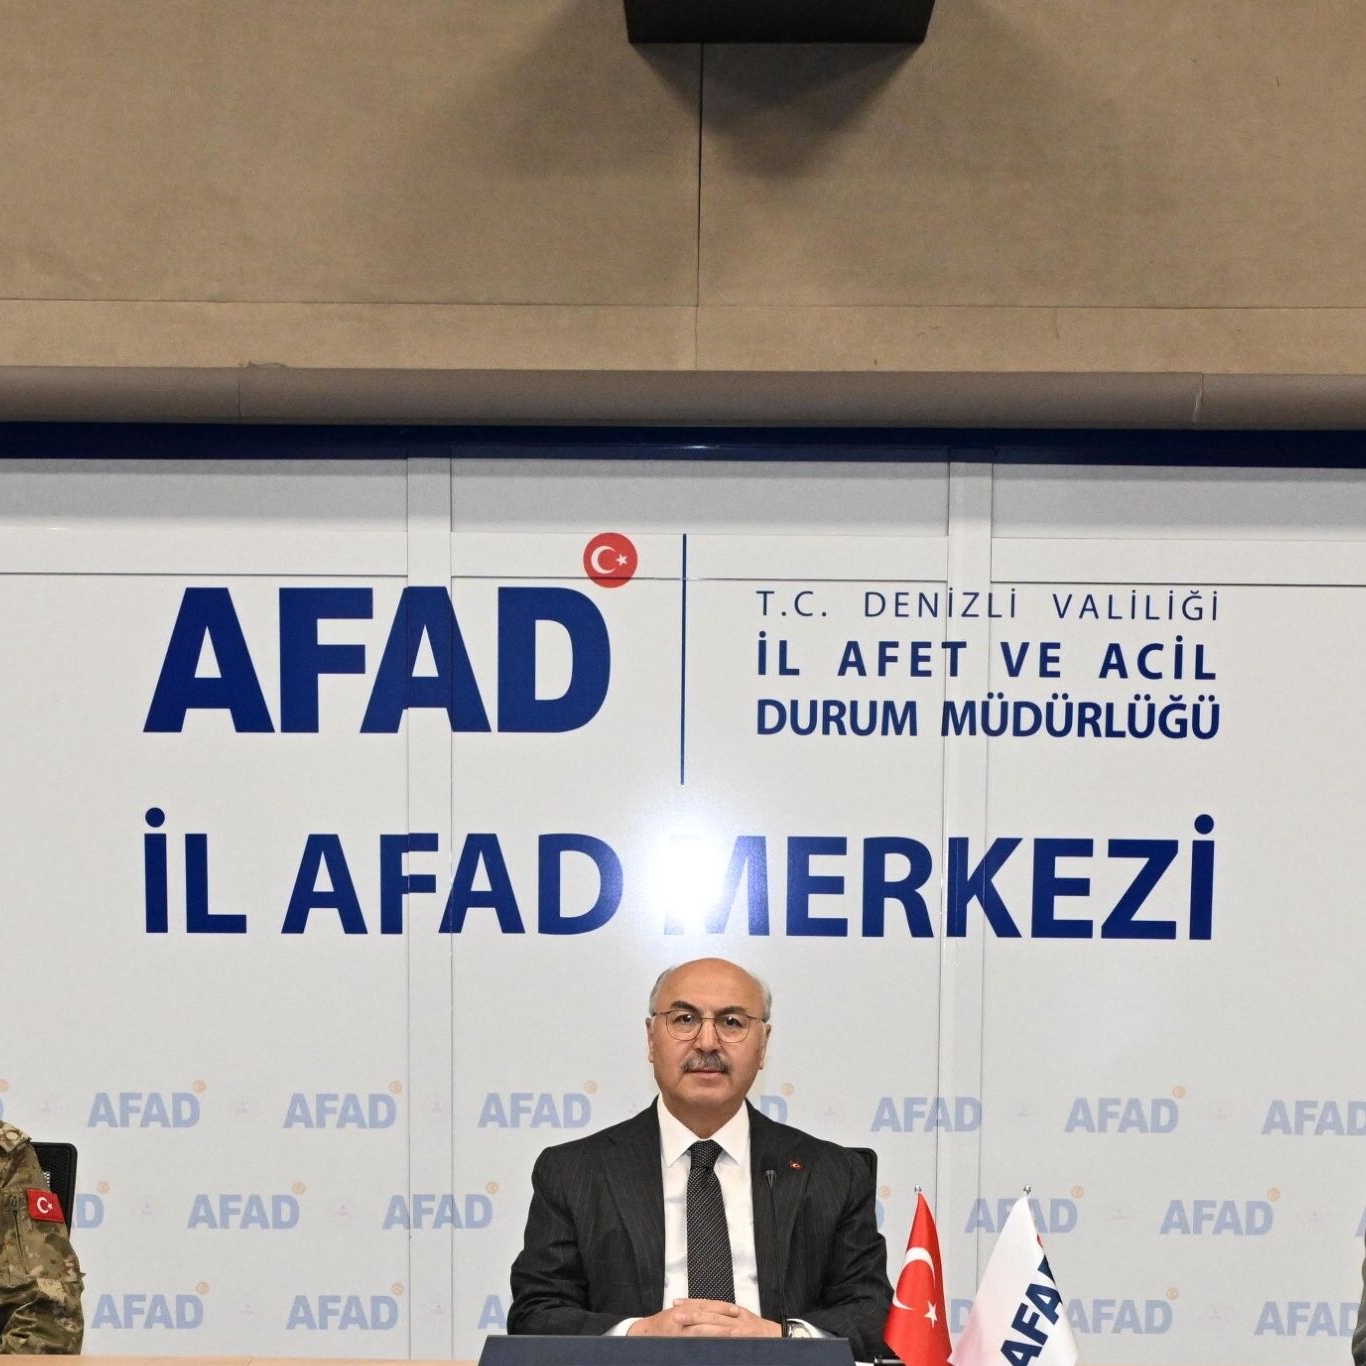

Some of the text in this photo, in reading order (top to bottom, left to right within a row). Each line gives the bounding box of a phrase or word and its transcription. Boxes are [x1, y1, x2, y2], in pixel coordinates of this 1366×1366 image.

[756, 586, 1218, 621] T.C. DENİZLİ VALİLİĞİ
[143, 586, 611, 733] AFAD
[756, 630, 1216, 681] İL AFET VE ACİL
[756, 692, 1220, 740] DURUM MÜDÜRLÜĞÜ
[144, 807, 1215, 941] İL AFAD MERKEZİ
[87, 1092, 201, 1128] AFAD
[283, 1093, 397, 1129] AFAD
[477, 1093, 592, 1129] AFAD
[870, 1097, 982, 1133] AFAD
[1064, 1098, 1179, 1134] AFAD
[187, 1194, 300, 1230] AFAD
[381, 1195, 493, 1230] AFAD
[1160, 1200, 1274, 1236] AFAD
[91, 1294, 204, 1330] AFAD
[286, 1295, 399, 1331] AFAD
